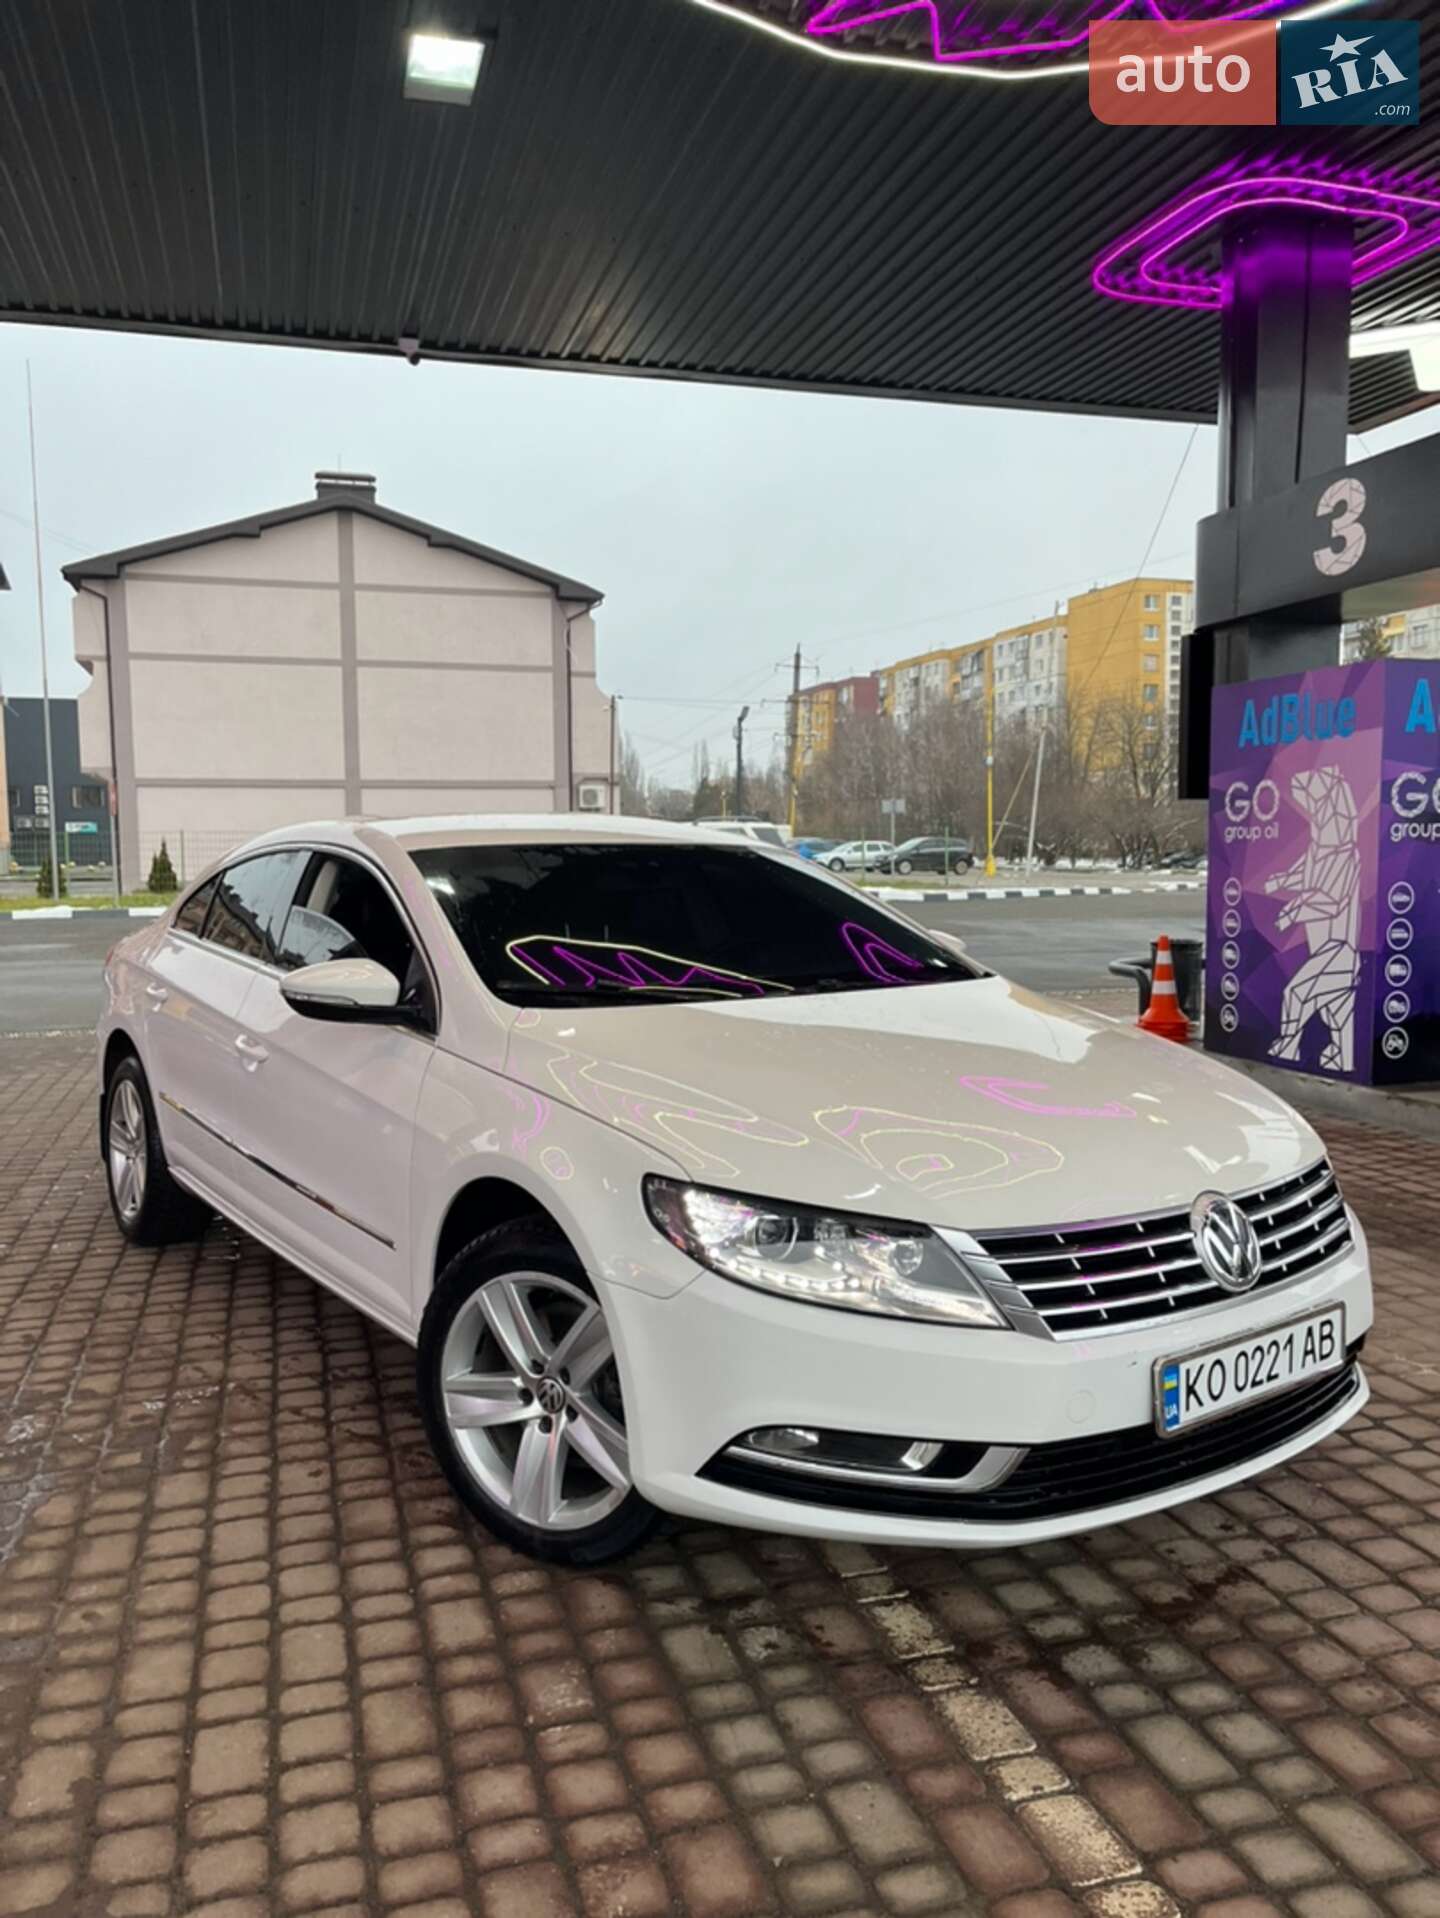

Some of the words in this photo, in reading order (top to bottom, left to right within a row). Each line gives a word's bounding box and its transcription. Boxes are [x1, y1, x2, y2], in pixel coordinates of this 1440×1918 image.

[1313, 477, 1367, 576] 3
[1238, 693, 1357, 748] AdBlue
[1405, 678, 1440, 733] A
[1225, 779, 1280, 822] GO
[1224, 826, 1262, 843] group
[1264, 823, 1279, 839] oil
[1184, 1359, 1227, 1412] KO
[1233, 1333, 1294, 1393] 0221
[1300, 1318, 1336, 1370] AB
